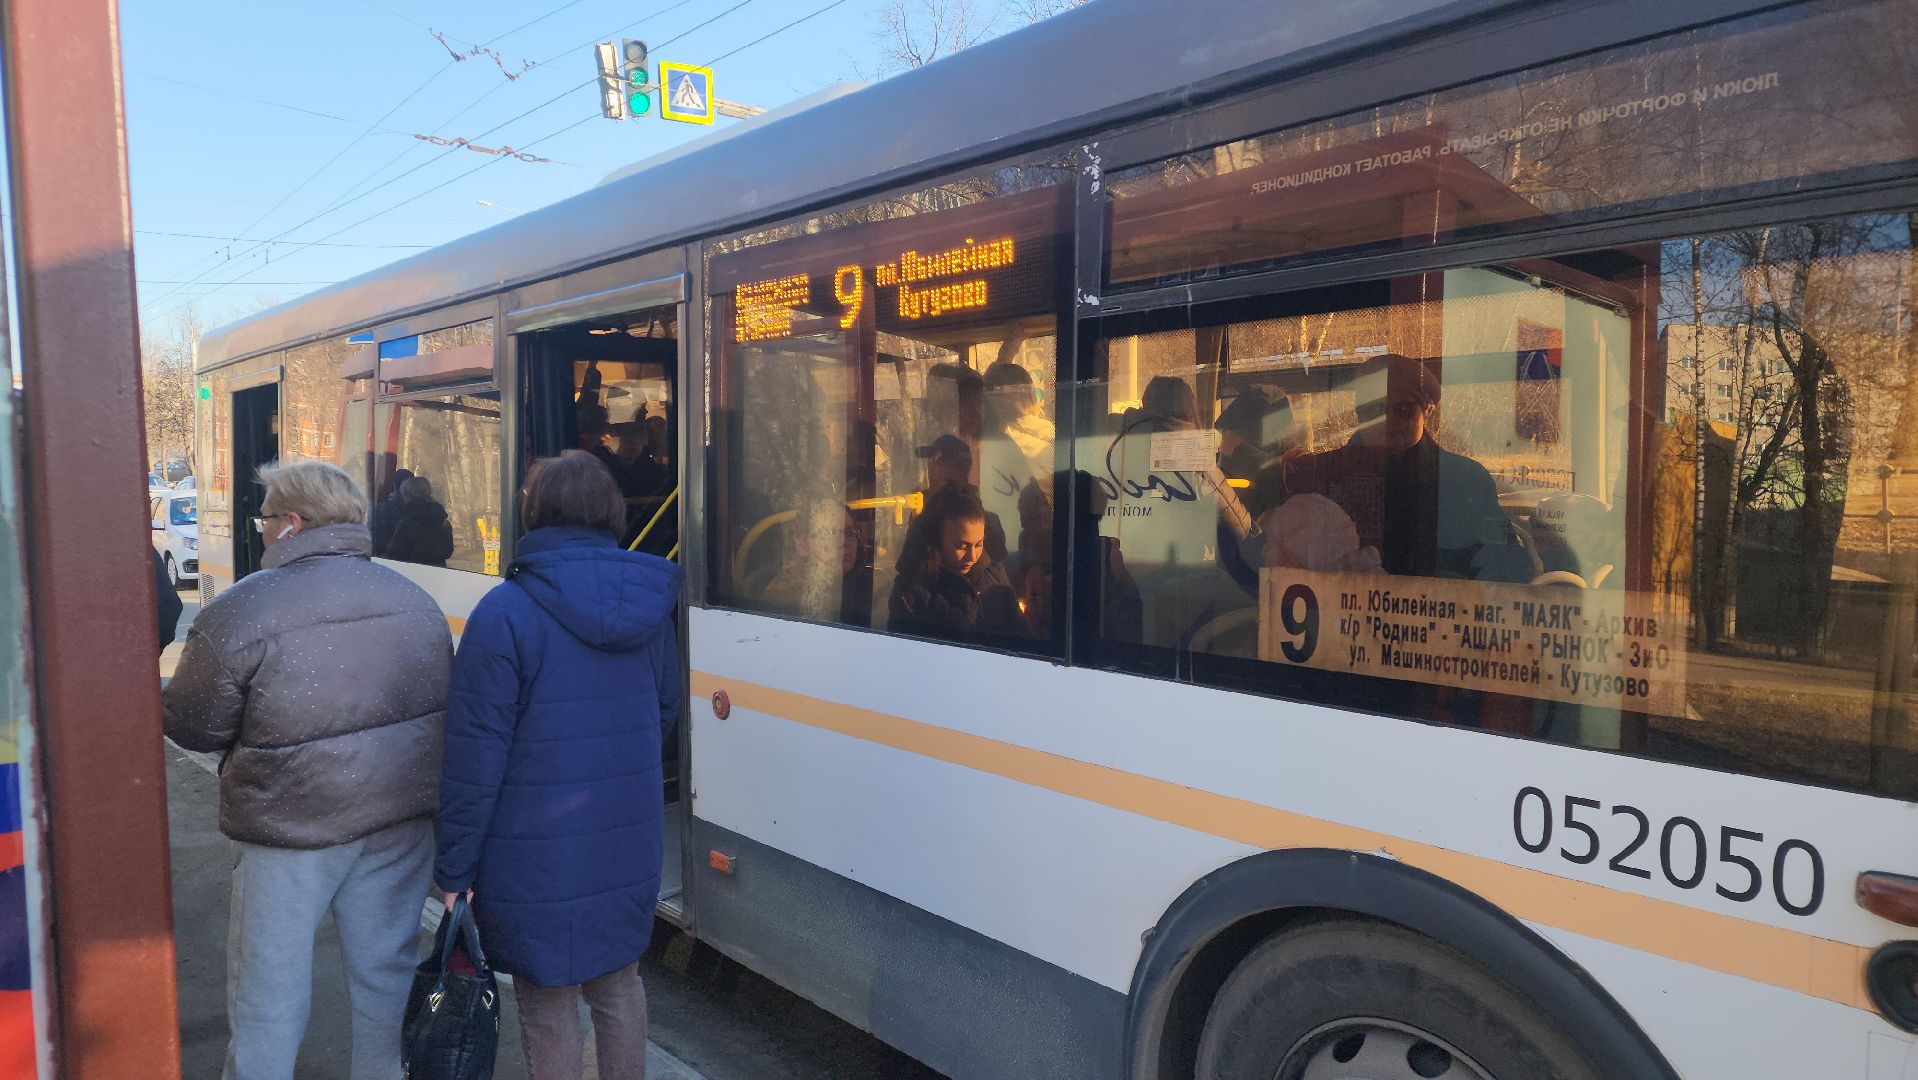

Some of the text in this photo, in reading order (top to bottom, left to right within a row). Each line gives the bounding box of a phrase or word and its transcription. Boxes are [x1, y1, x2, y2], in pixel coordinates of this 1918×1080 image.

[834, 263, 863, 329] 9
[1280, 583, 1320, 664] 9
[1340, 592, 1362, 611] пл.
[1368, 590, 1456, 619] Юбилейная
[1474, 604, 1505, 624] маг.
[1595, 609, 1658, 640] Архив
[1340, 614, 1360, 641] к/р
[1366, 615, 1436, 644] "Родина"
[1453, 623, 1521, 653] "АШАН"
[1541, 633, 1609, 663] РЫНОК
[1350, 645, 1370, 666] ул.
[1381, 643, 1540, 684] Машиностроителей
[1560, 663, 1650, 698] Кутузово
[1512, 786, 1825, 917] 052050
